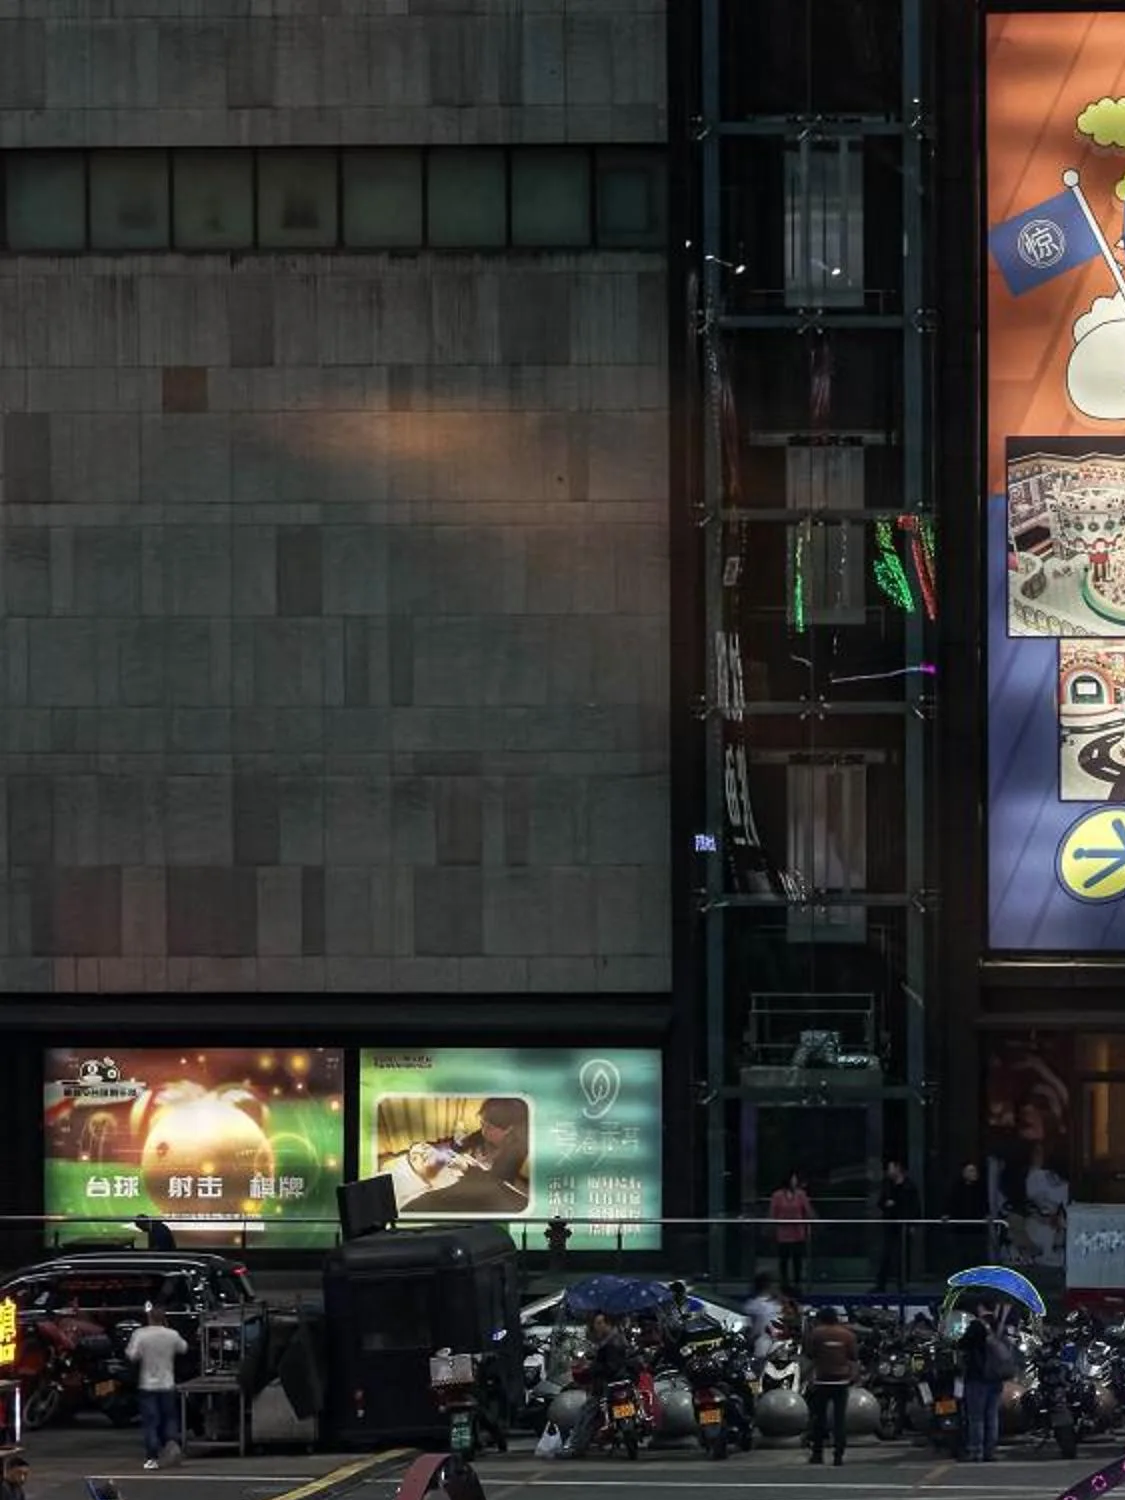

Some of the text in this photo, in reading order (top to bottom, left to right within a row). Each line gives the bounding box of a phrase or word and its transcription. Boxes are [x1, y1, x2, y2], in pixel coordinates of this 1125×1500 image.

[1021, 222, 1062, 266] 惊
[86, 1175, 140, 1199] 台球
[168, 1175, 223, 1198] 射击
